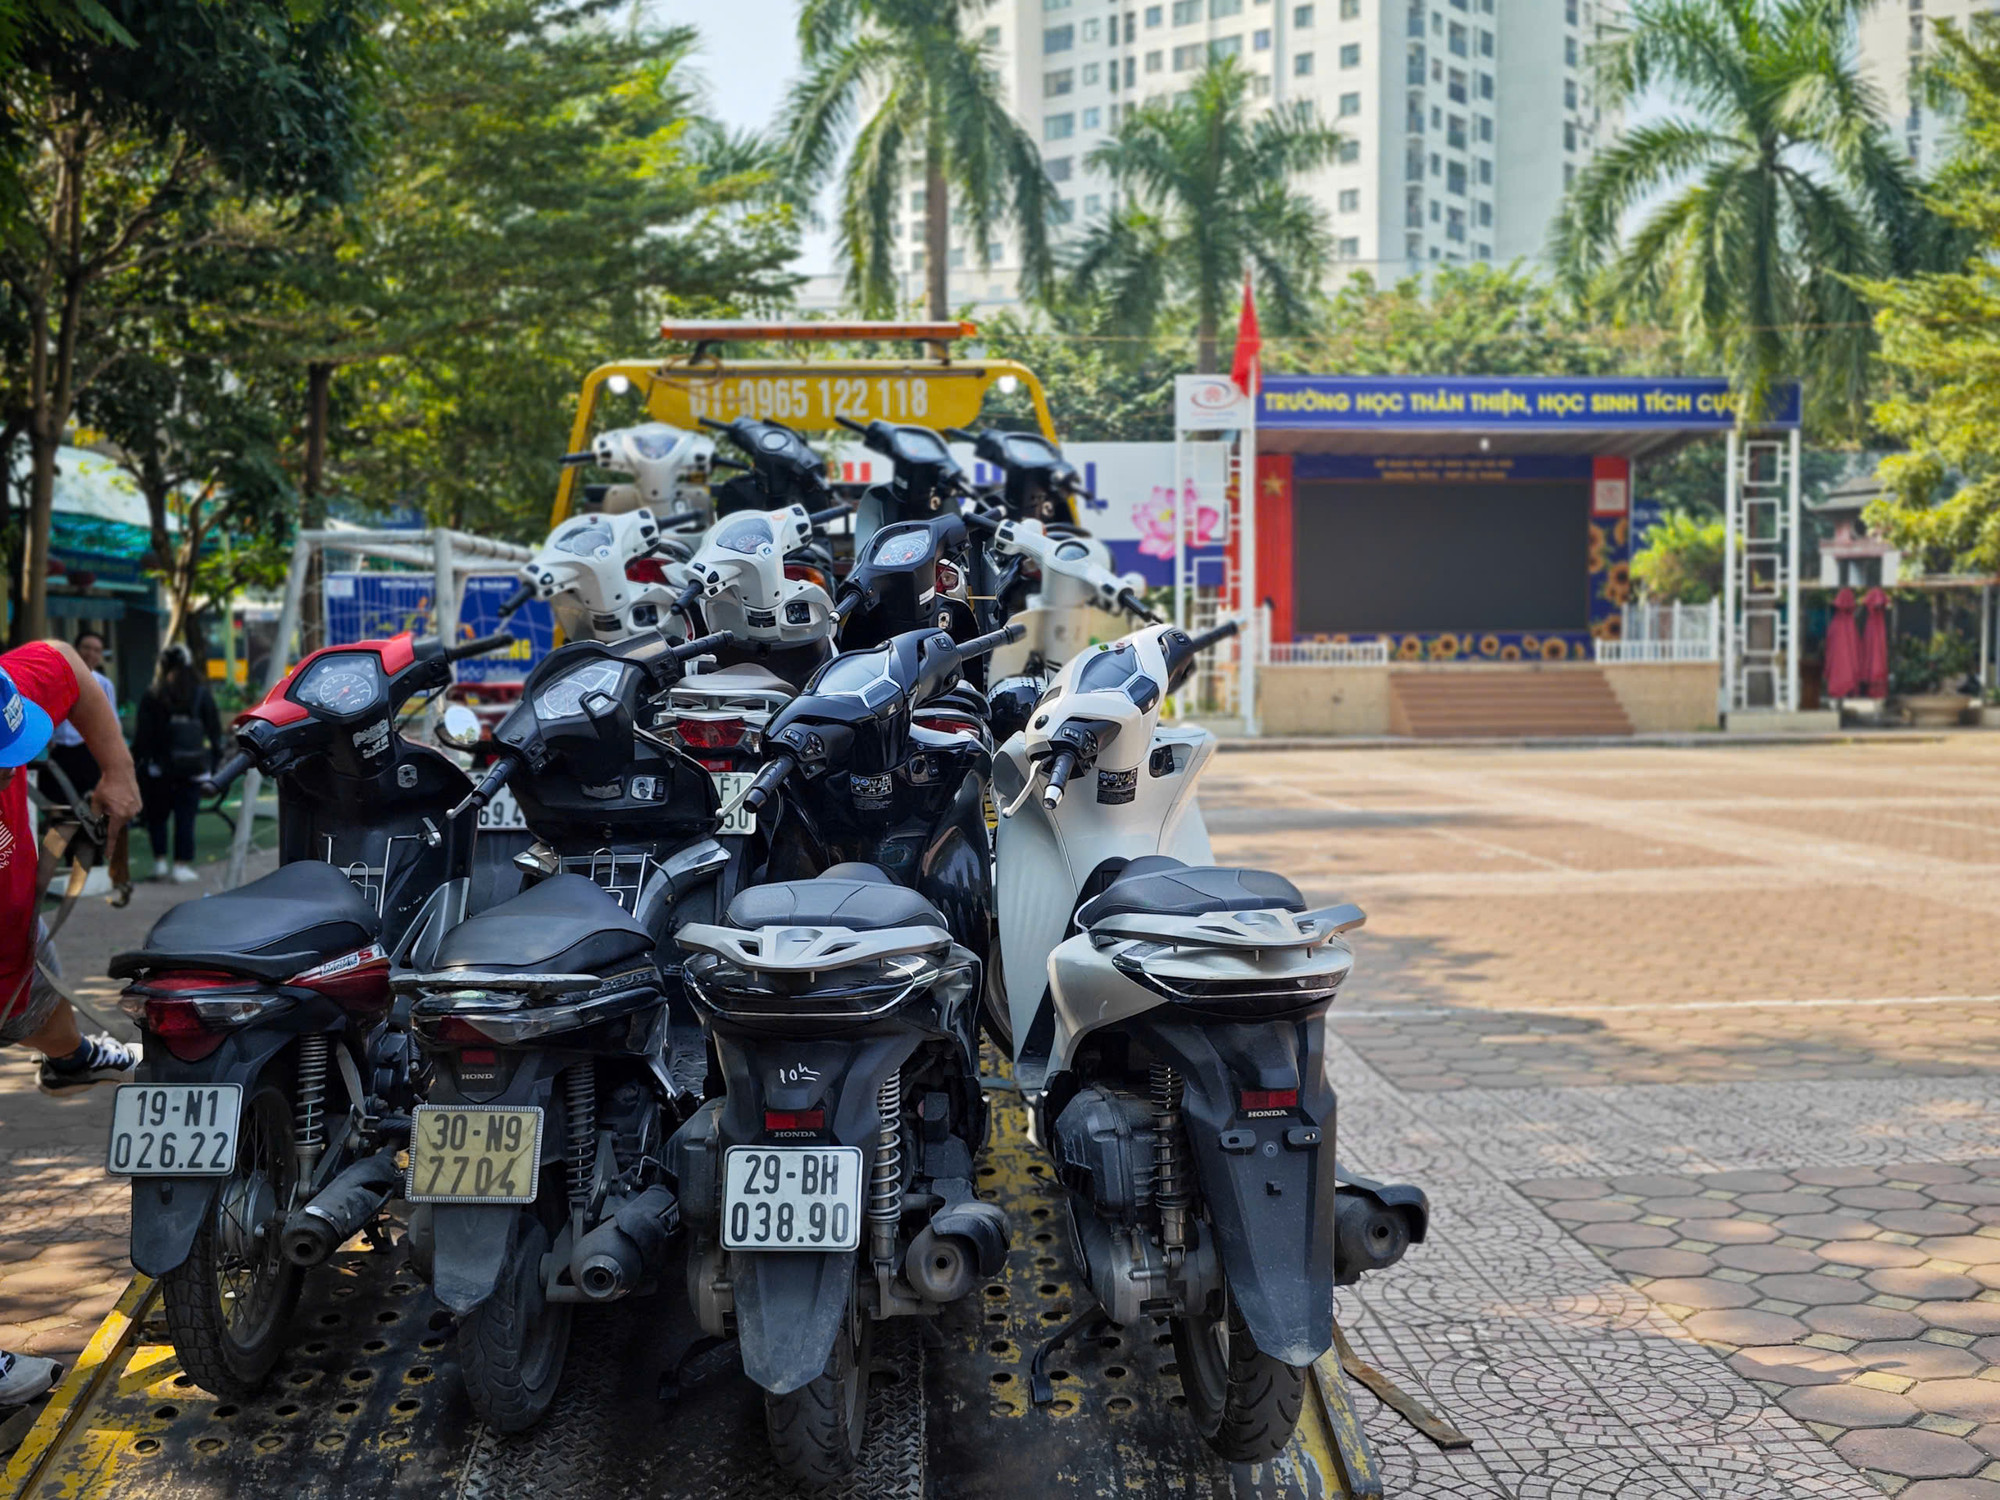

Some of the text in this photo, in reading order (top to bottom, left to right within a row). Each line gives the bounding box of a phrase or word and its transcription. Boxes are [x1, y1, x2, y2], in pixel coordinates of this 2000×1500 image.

[818, 378, 869, 418] 122
[876, 378, 928, 418] 118
[1264, 387, 1350, 411] TRƯỜNG
[1356, 392, 1404, 418] HỌC
[1410, 388, 1464, 412] THÂN
[1537, 393, 1585, 418] HỌC
[1591, 393, 1638, 413] SINH
[1643, 388, 1691, 413] TÍCH
[137, 1090, 219, 1127] 19-N1
[1247, 1109, 1288, 1118] HONDA
[114, 1132, 229, 1169] 026.22
[431, 1113, 523, 1152] 30-N9
[425, 1156, 516, 1197] 7704
[743, 1154, 840, 1195] 29-BH
[731, 1202, 850, 1243] 038.90
